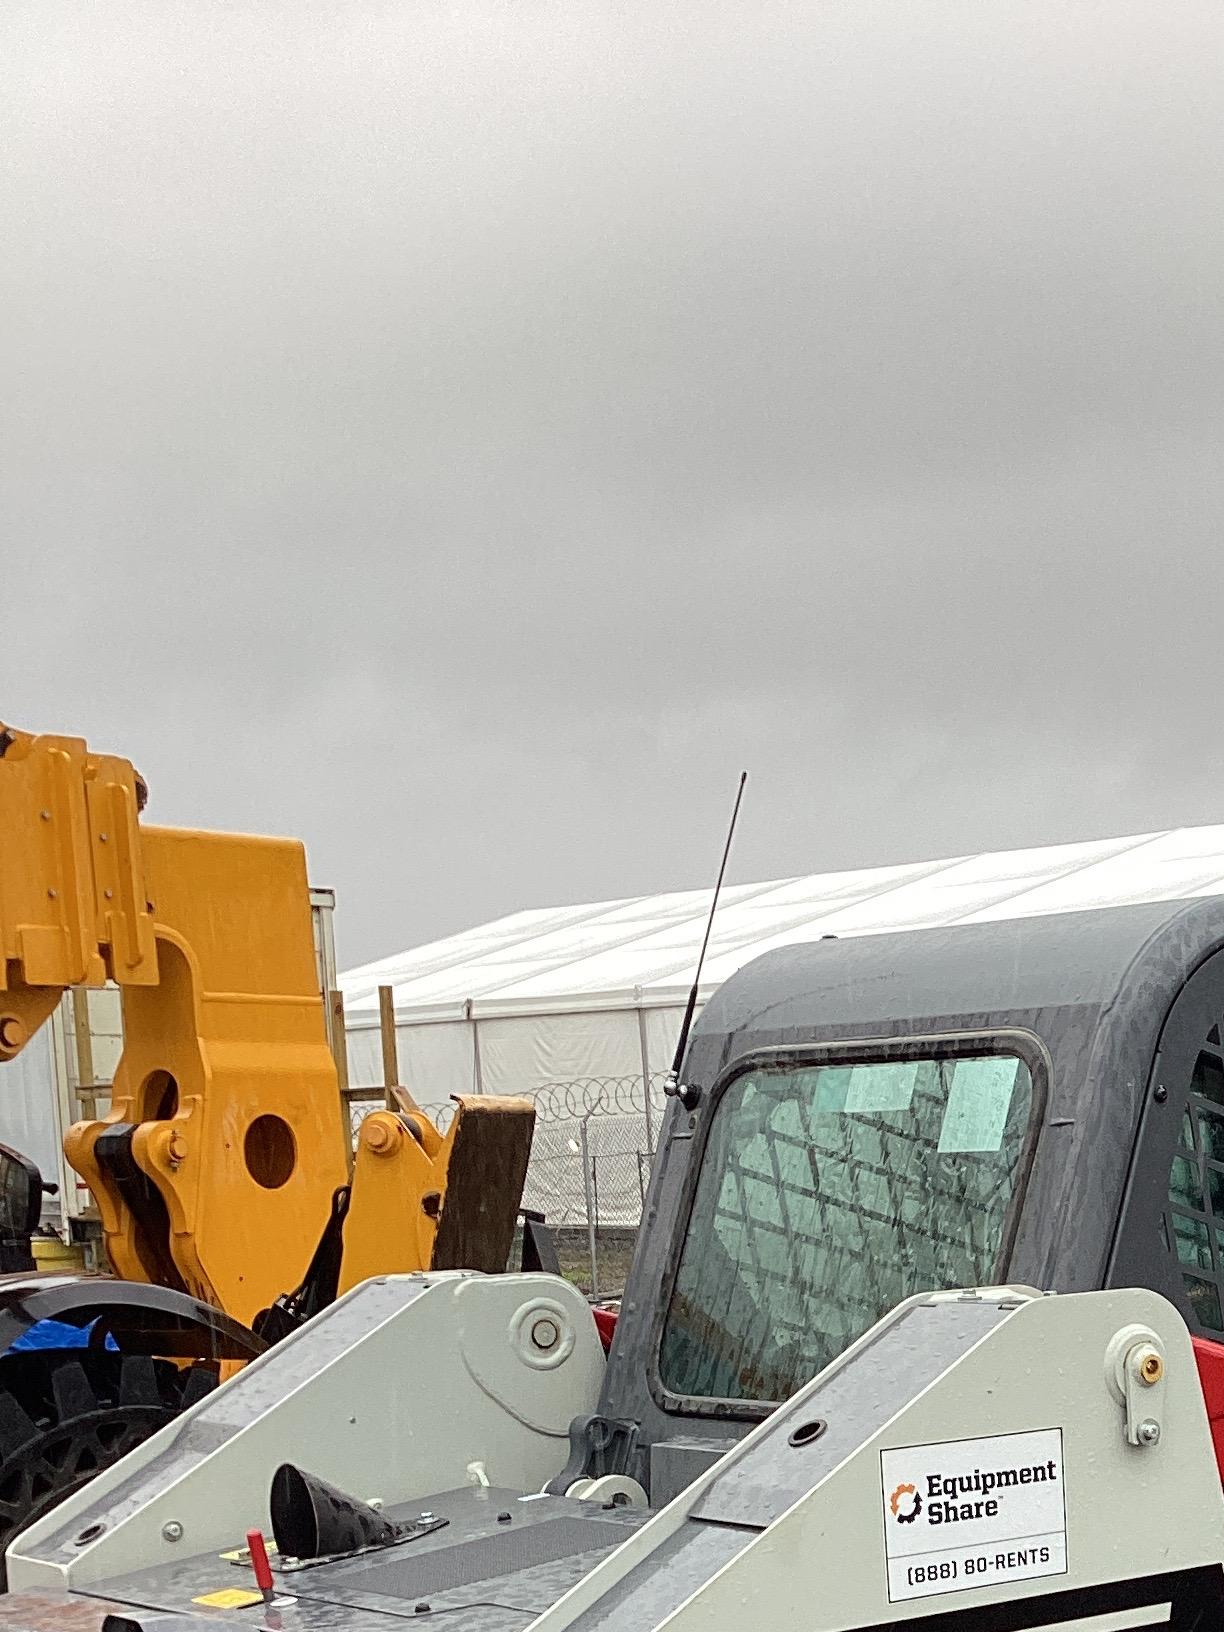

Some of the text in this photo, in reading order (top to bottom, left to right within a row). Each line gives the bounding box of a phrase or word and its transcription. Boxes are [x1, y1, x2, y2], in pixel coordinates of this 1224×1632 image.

[926, 1460, 1057, 1500] Equipment
[927, 1499, 999, 1526] Share
[907, 1547, 1050, 1586] (888) 80-RENTS
